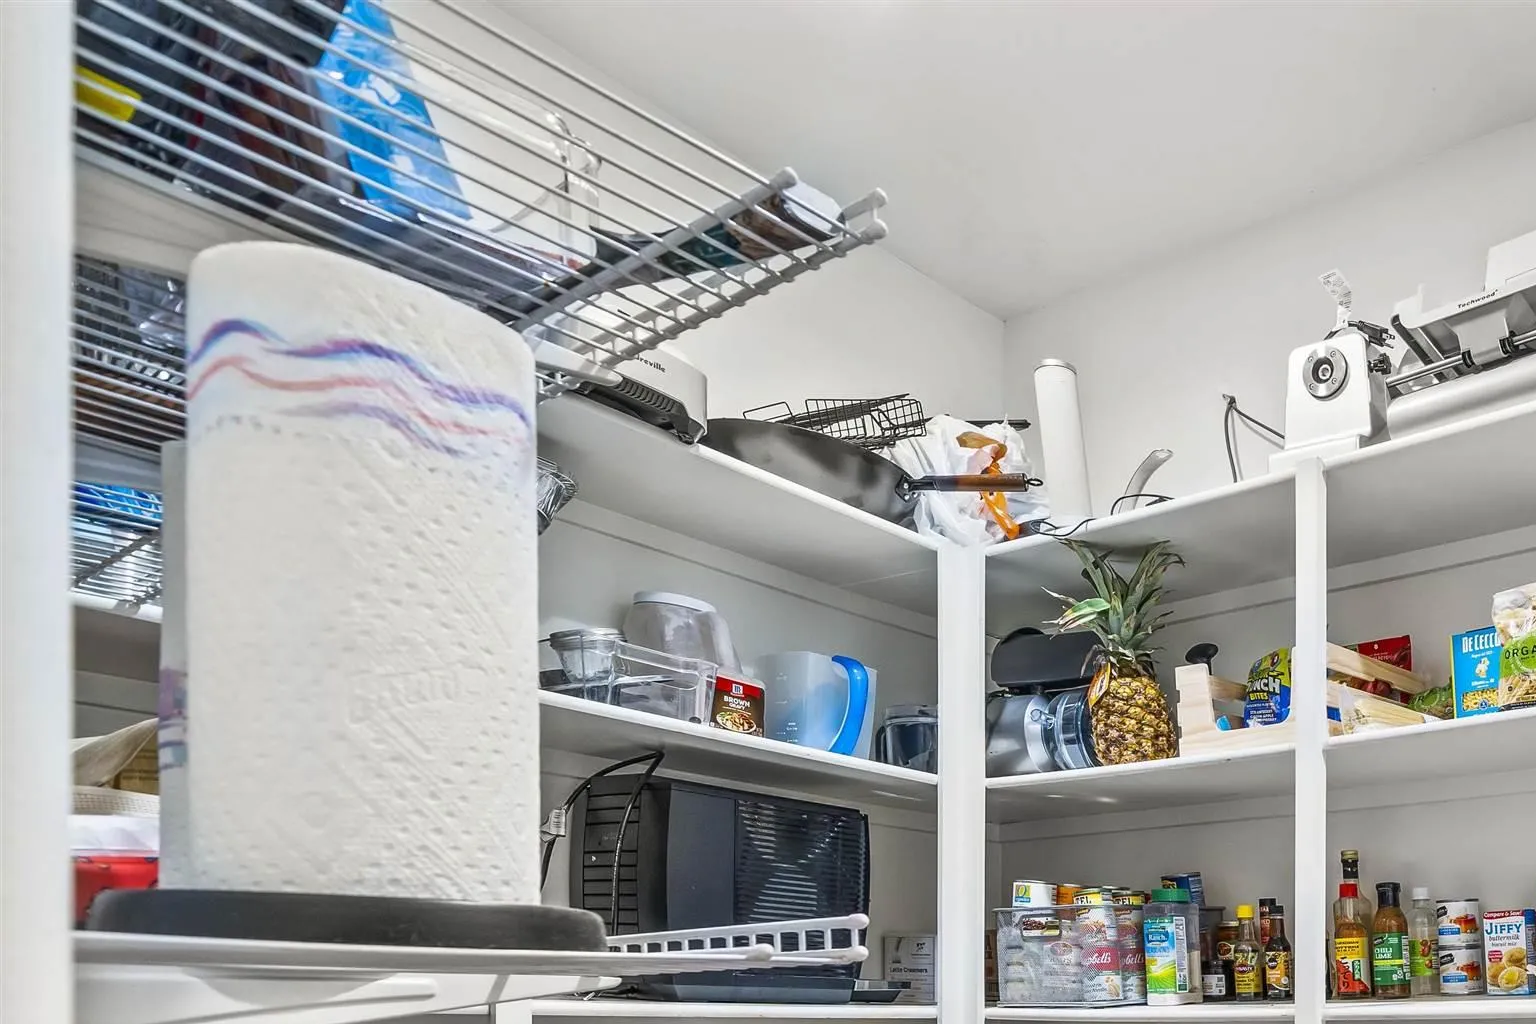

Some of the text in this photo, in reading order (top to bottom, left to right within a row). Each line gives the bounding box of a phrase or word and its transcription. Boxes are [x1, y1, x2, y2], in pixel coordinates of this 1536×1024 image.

[1458, 292, 1495, 308] Techwood
[1462, 636, 1473, 653] DE
[723, 695, 750, 707] BROWN
[1249, 692, 1268, 701] BITES
[1485, 923, 1522, 935] JIFFY
[1489, 934, 1520, 942] buttermilk
